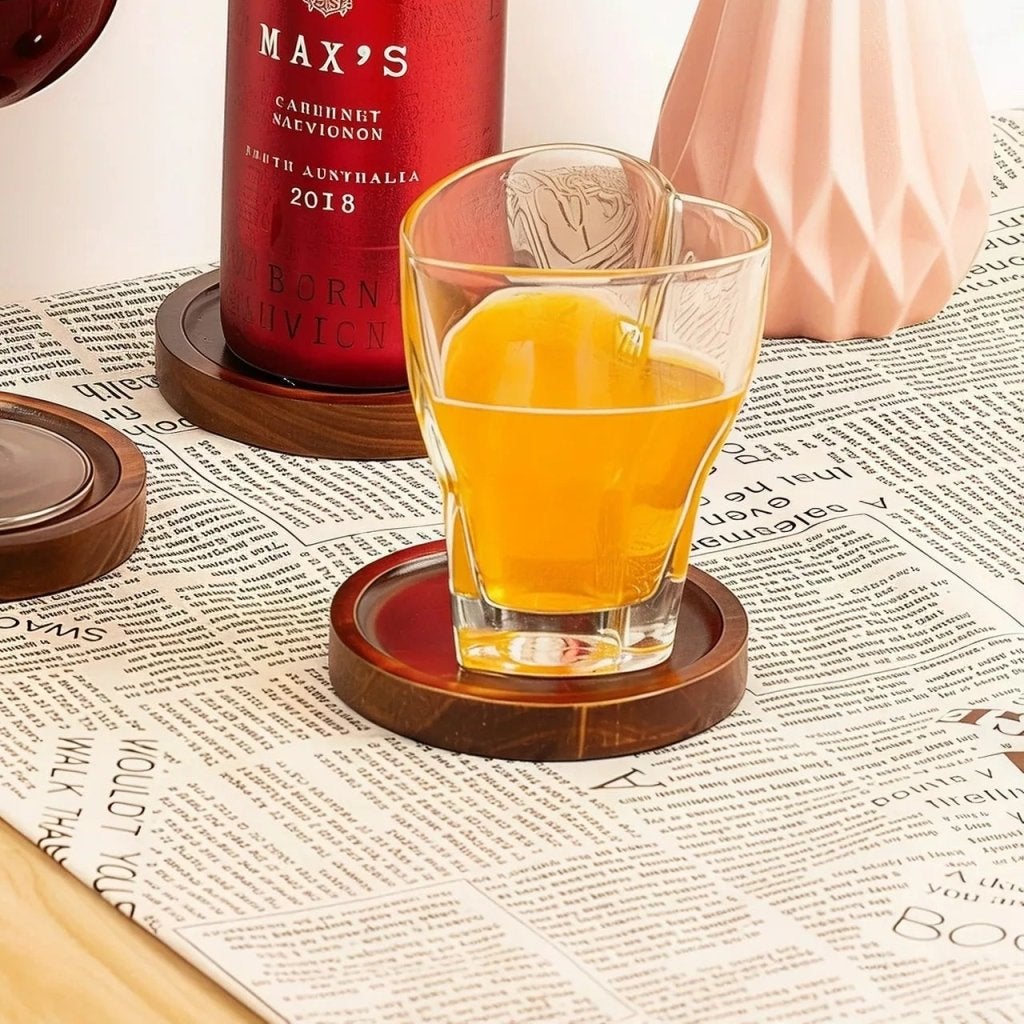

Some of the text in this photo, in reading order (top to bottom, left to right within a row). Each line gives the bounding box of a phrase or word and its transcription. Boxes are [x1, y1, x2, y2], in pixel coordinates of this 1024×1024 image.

[258, 22, 408, 78] MAX'S
[290, 186, 356, 214] 2018
[47, 736, 96, 797] WALK
